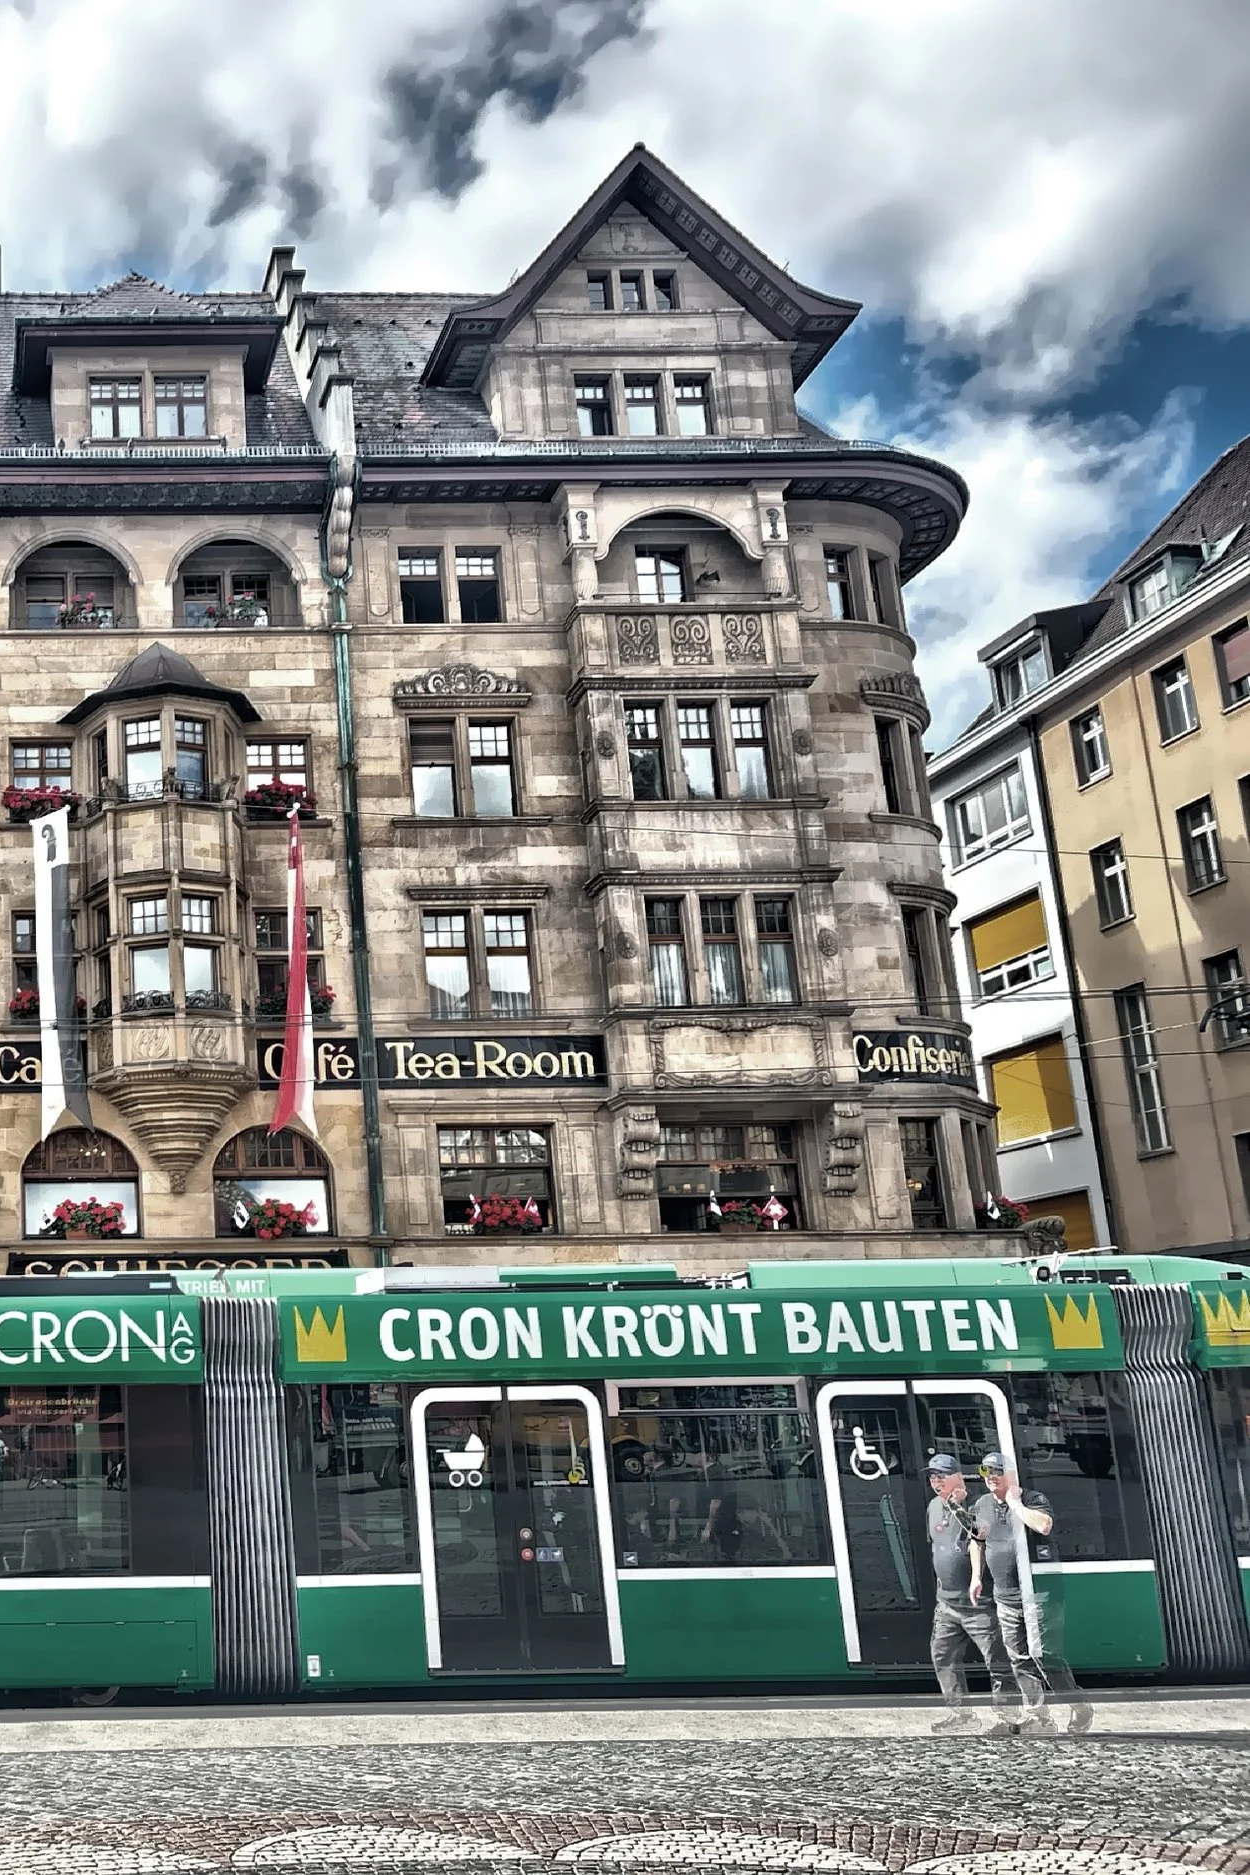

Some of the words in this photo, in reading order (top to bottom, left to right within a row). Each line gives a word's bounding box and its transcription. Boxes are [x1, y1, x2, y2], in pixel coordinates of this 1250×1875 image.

[263, 1042, 355, 1083] Cfé
[385, 1041, 596, 1080] Tea-Room
[235, 1279, 266, 1294] MIT
[379, 1307, 543, 1362] CRON
[562, 1303, 762, 1359] KRÖNT
[781, 1299, 1019, 1354] BAUTEN
